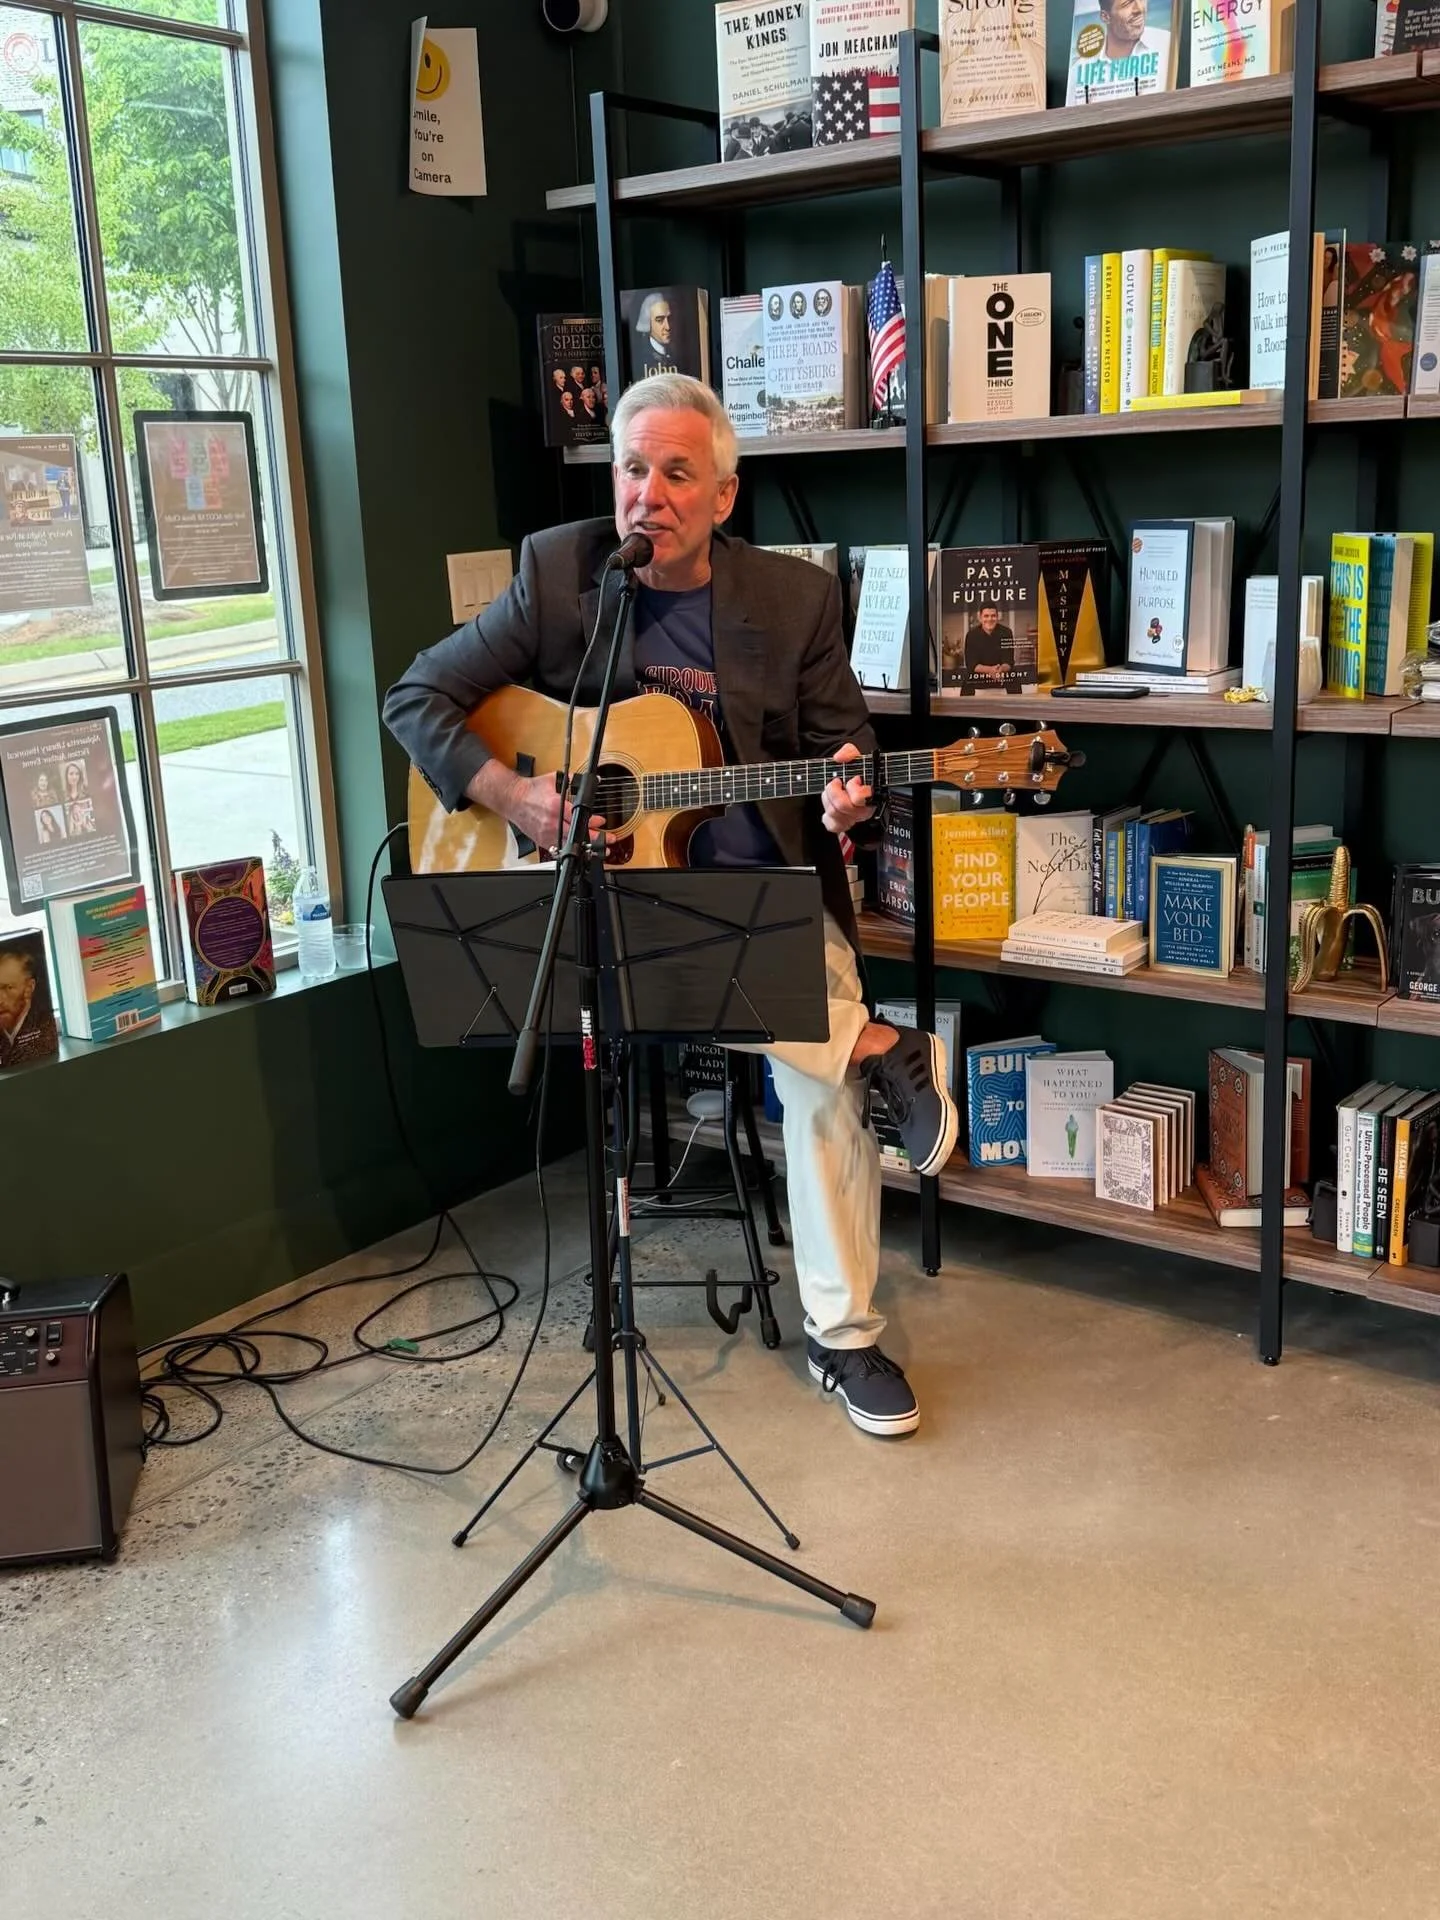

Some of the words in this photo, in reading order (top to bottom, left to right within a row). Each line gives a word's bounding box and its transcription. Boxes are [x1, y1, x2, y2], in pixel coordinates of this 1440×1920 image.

[724, 17, 750, 35] THE
[755, 3, 802, 28] MONEY
[746, 28, 787, 50] KINGS
[1021, 31, 1037, 39] Well
[819, 41, 839, 57] JON
[844, 34, 898, 54] MEACHAM
[1077, 61, 1106, 87] LIFE
[1110, 52, 1160, 82] FORCE
[1197, 66, 1216, 76] CASEY
[732, 88, 761, 100] DANIEL
[764, 77, 809, 92] SCHULMAN
[414, 129, 444, 143] You're
[422, 152, 434, 162] on
[414, 168, 452, 184] Camera
[992, 283, 1008, 291] THE
[1088, 264, 1097, 305] Martha
[1127, 264, 1135, 313] OUTLIVE
[1258, 292, 1275, 308] How
[1278, 290, 1288, 304] to
[1088, 308, 1097, 336] Beck
[1253, 313, 1273, 331] Walk
[553, 334, 604, 350] SPEEC
[1257, 344, 1263, 354] a
[767, 342, 798, 361] THREE
[803, 340, 838, 357] ROADS
[727, 354, 766, 370] Challe
[644, 362, 678, 380] John
[768, 363, 836, 383] GETTYSBURG
[987, 379, 1013, 388] THING
[729, 402, 750, 411] Adam
[729, 412, 766, 423] Higginbot
[869, 567, 884, 578] THE
[886, 567, 907, 579] NEED
[967, 565, 1013, 579] PAST
[1139, 566, 1178, 581] HUMBLED
[867, 580, 878, 592] TO
[1331, 561, 1351, 601] THIS
[1353, 563, 1364, 600] IS
[865, 595, 901, 610] WHOLE
[953, 588, 1027, 604] FUTURE
[1137, 596, 1176, 609] PURPOSE
[1058, 569, 1069, 657] MASTERY
[1343, 605, 1362, 644] THE
[861, 629, 895, 642] WENDELL
[859, 643, 881, 654] BERRY
[645, 666, 718, 695] CIRQUE
[889, 825, 911, 839] EMON
[943, 828, 977, 840] Jennie
[977, 826, 1008, 837] Allen
[1047, 832, 1077, 847] The
[883, 844, 913, 859] UNREST
[954, 852, 997, 868] FIND
[1027, 859, 1065, 874] Next
[1068, 856, 1093, 875] Day
[889, 880, 906, 895] ERIK
[950, 871, 1004, 888] YOUR
[881, 891, 915, 914] LARSON
[942, 891, 1011, 909] PEOPLE
[1164, 894, 1213, 912] MAKE
[1163, 910, 1213, 928] YOUR
[1173, 927, 1202, 943] BED
[1409, 981, 1437, 992] GEORGE
[685, 1043, 724, 1055] LINCOL
[699, 1058, 725, 1069] LADY
[685, 1070, 724, 1081] SPYMAS
[1057, 1069, 1088, 1077] WHAT
[1043, 1080, 1103, 1088] HAPPENED
[1007, 1100, 1024, 1111] TO
[980, 1138, 1027, 1161] MOV
[1399, 1139, 1407, 1159] STAY
[1363, 1130, 1373, 1199] Ultra-Processed
[1378, 1168, 1388, 1183] BE
[1376, 1187, 1387, 1219] SEEN
[1362, 1201, 1372, 1230] People
